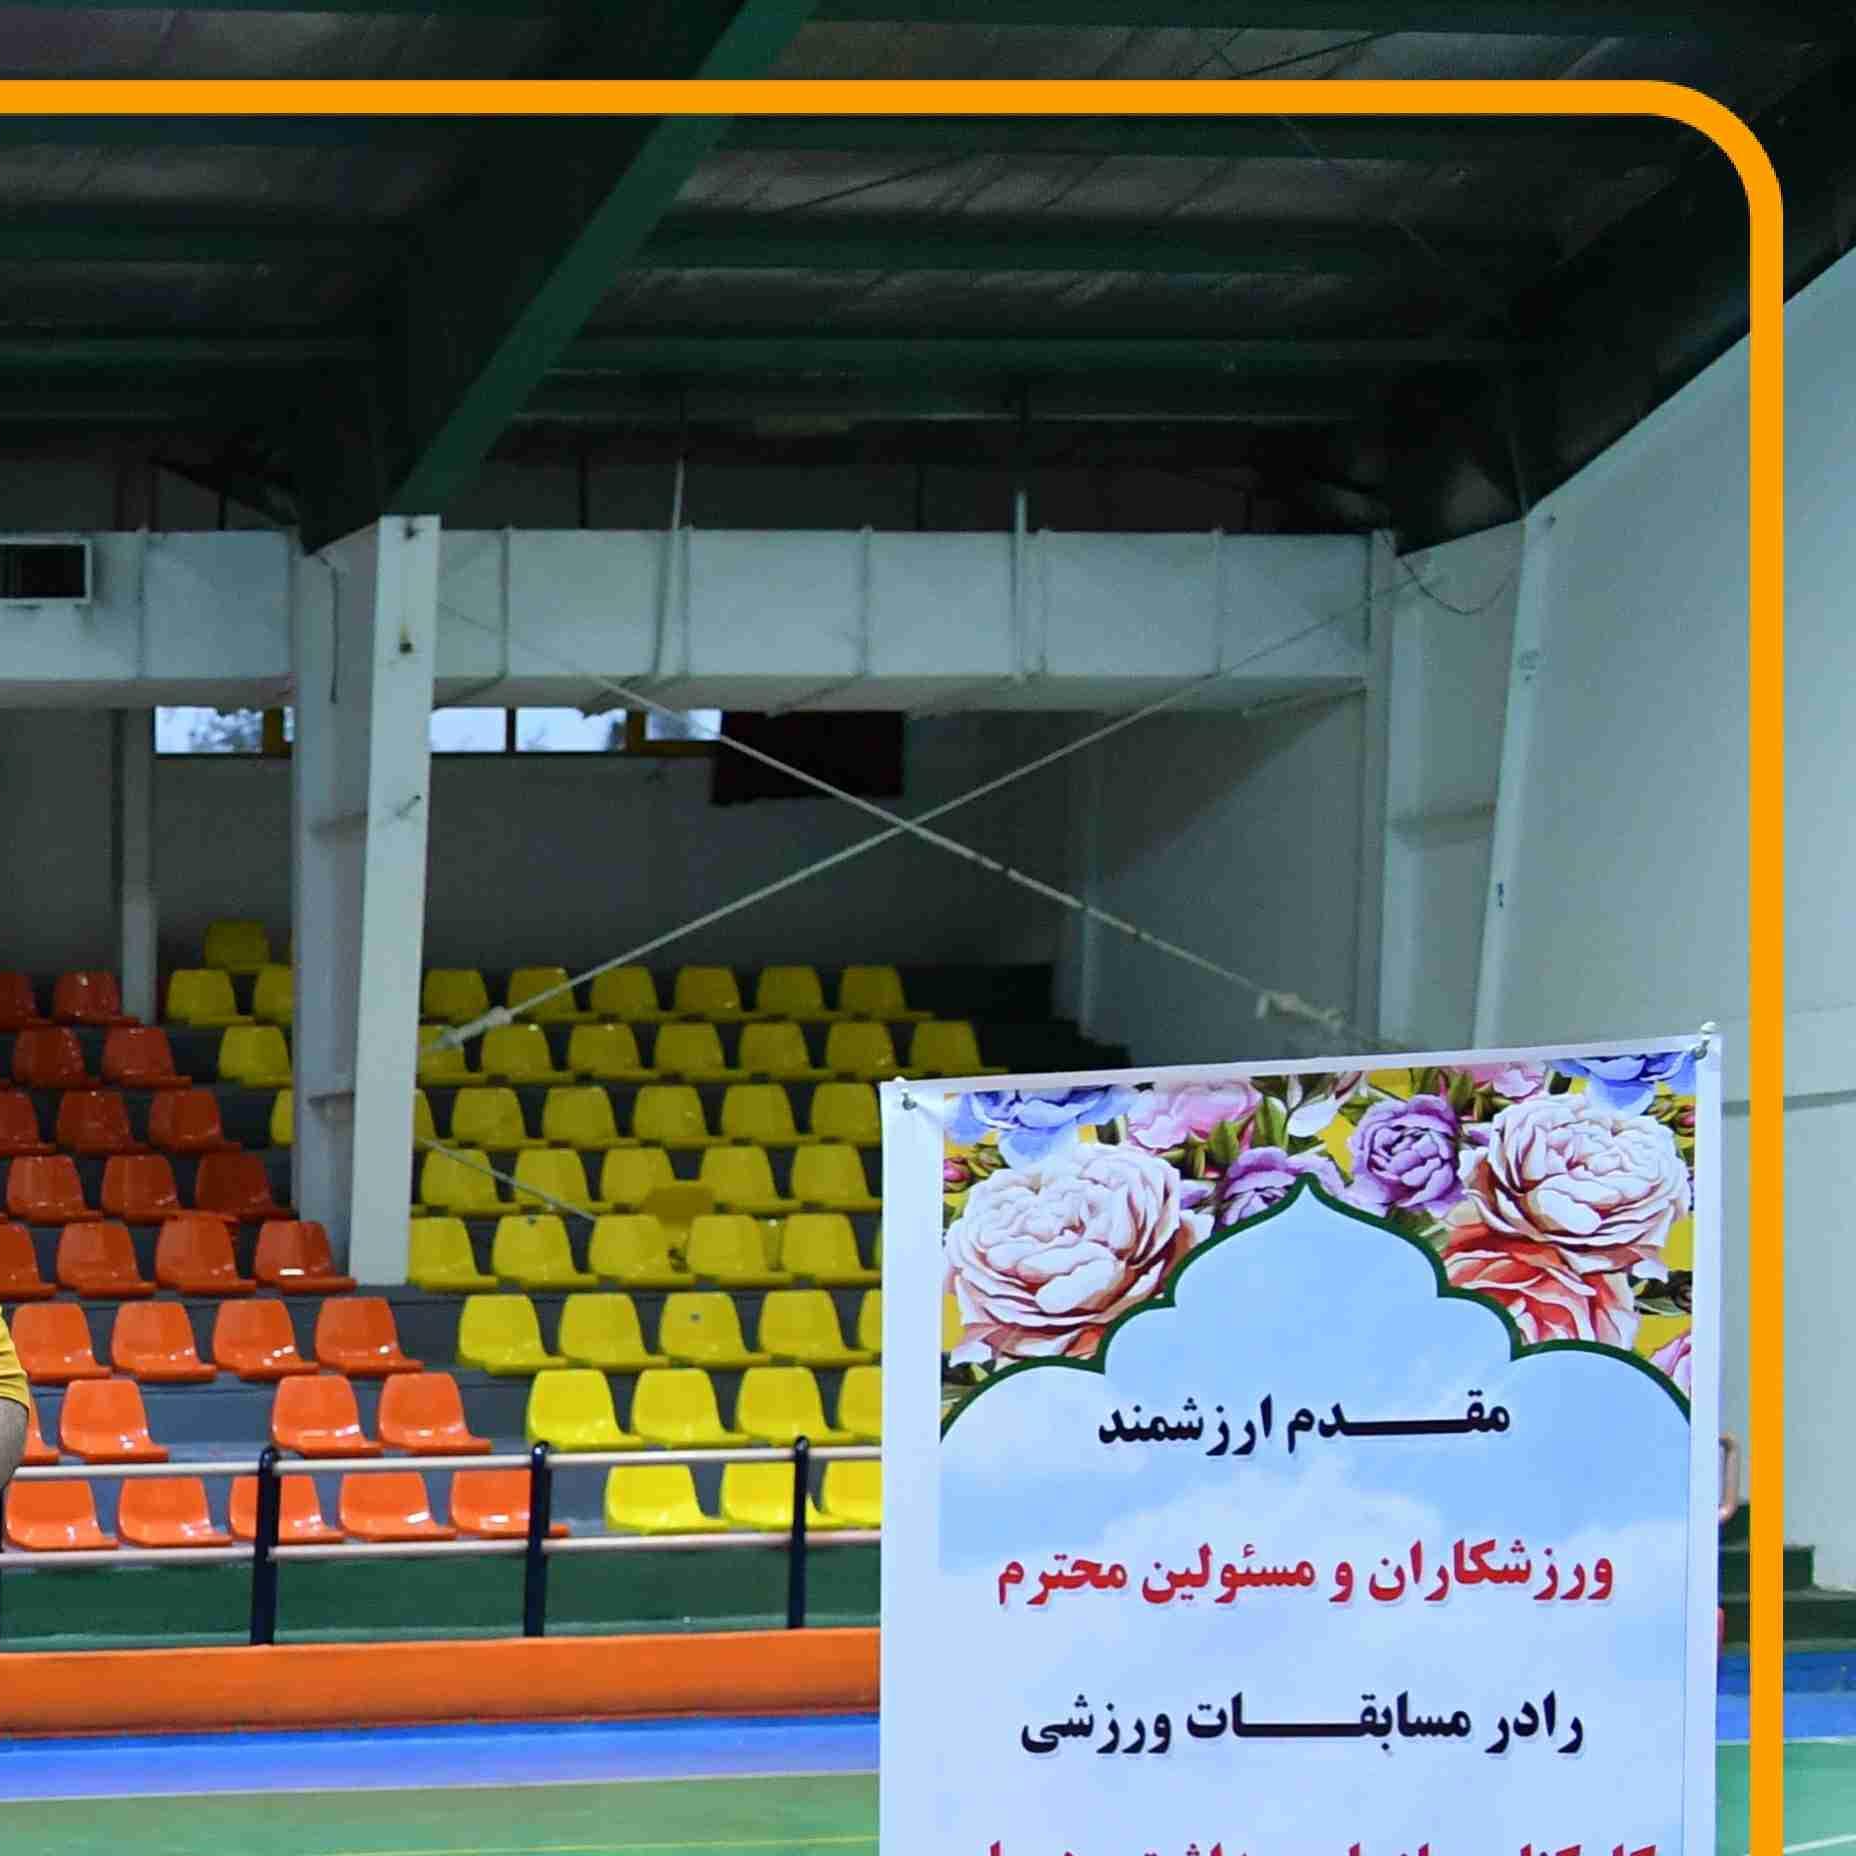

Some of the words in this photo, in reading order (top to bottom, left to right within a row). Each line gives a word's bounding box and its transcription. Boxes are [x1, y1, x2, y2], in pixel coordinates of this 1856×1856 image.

[1098, 1393, 1273, 1457] ارزشمند
[997, 1553, 1128, 1607] محترم
[1140, 1544, 1316, 1605] مسئولین
[1331, 1561, 1356, 1606] و
[1367, 1539, 1614, 1602] ورزشکاران
[1021, 1694, 1172, 1754] ورزشی
